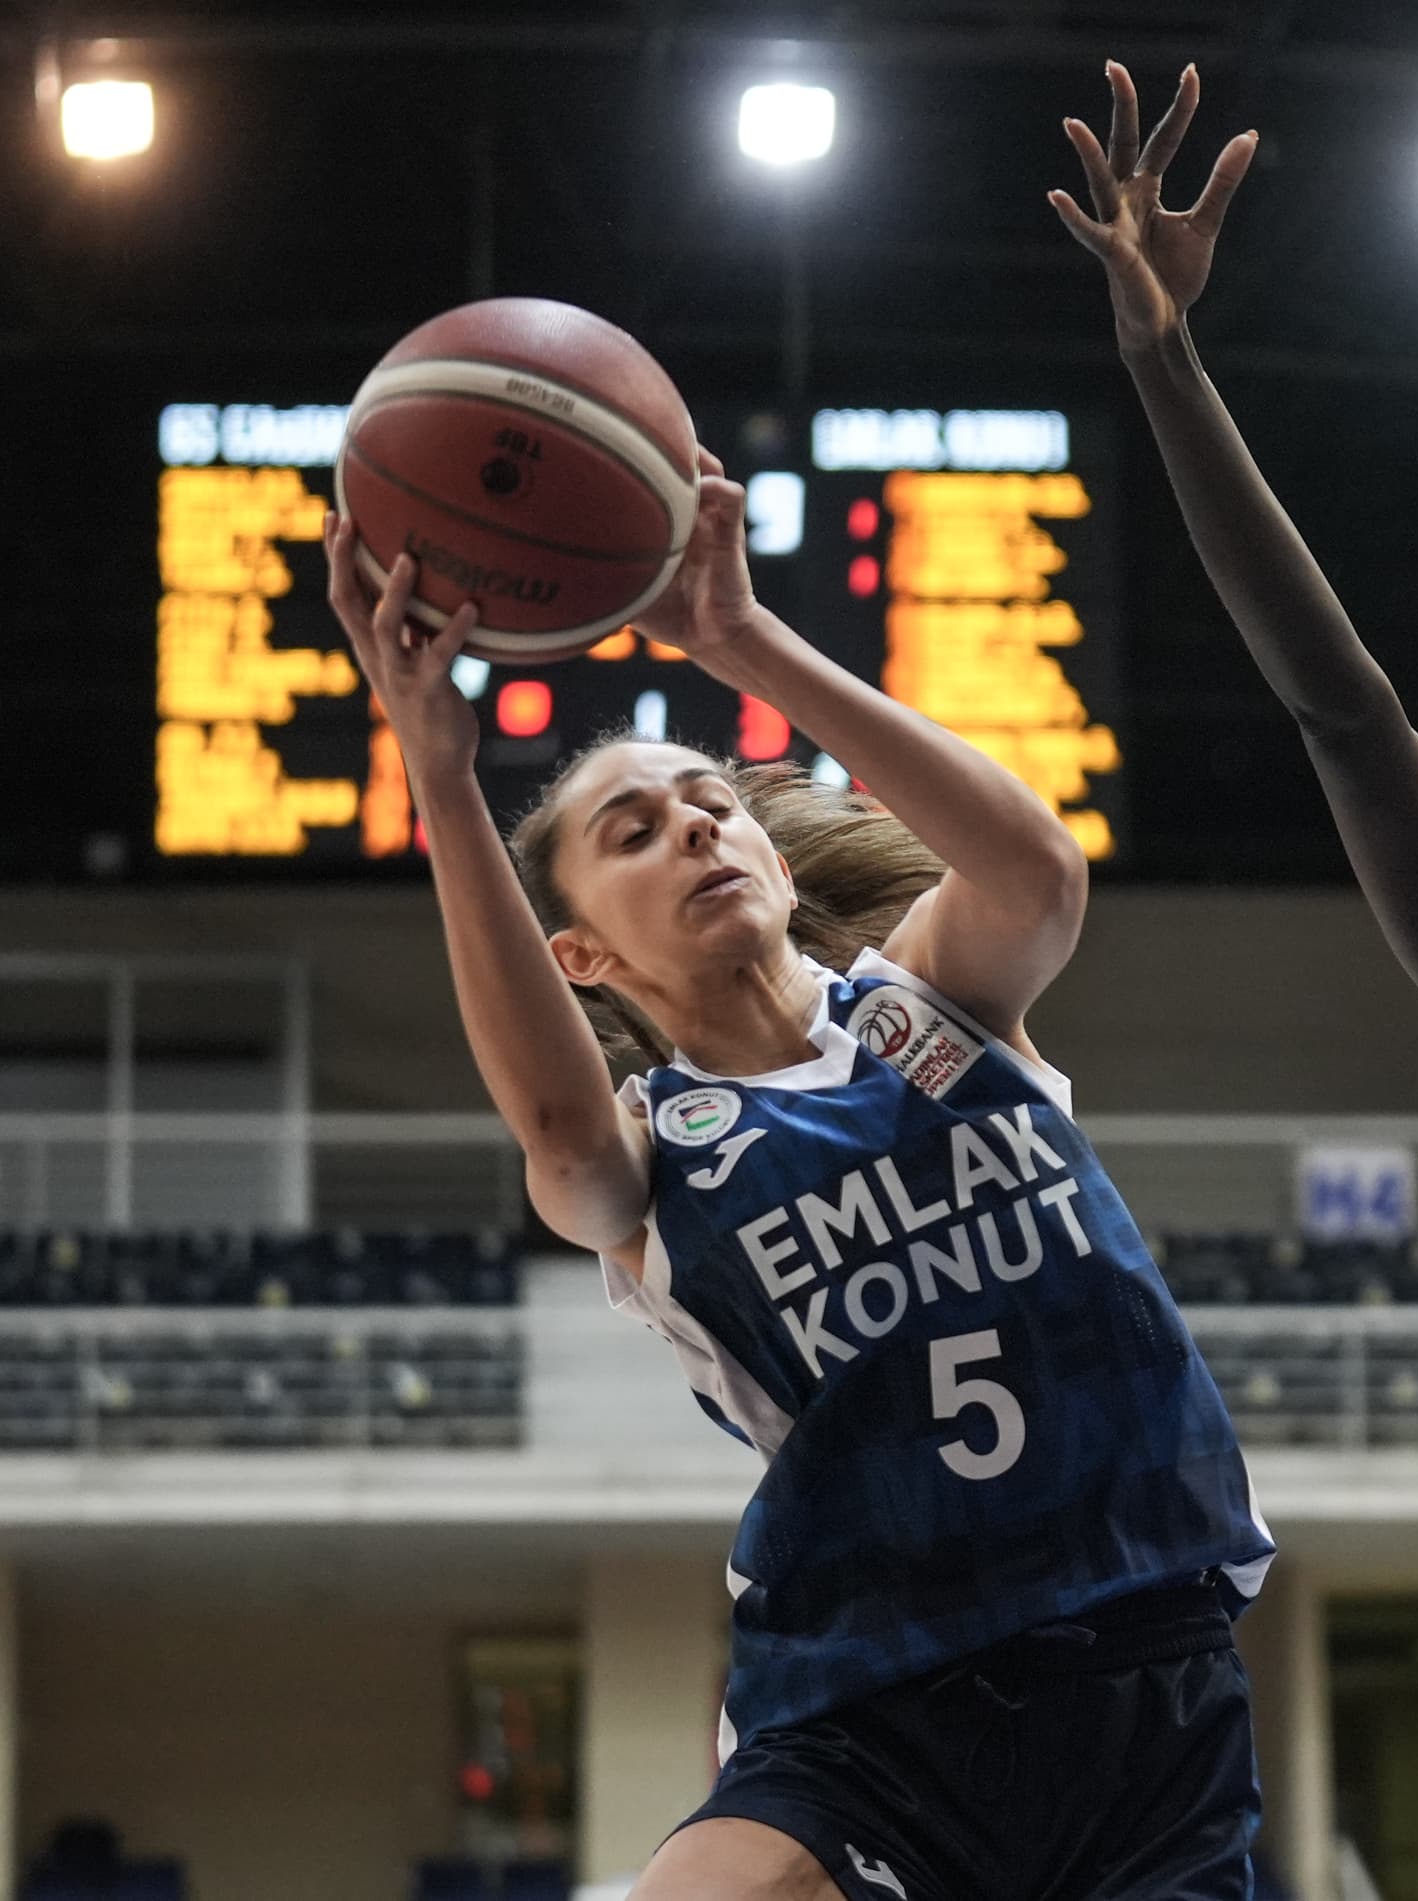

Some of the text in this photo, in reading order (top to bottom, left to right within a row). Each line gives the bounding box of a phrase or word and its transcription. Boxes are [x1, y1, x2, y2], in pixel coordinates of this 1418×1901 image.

[736, 1103, 1068, 1301] EMLAK
[779, 1177, 1093, 1380] KONUT
[928, 1328, 1027, 1481] 5
